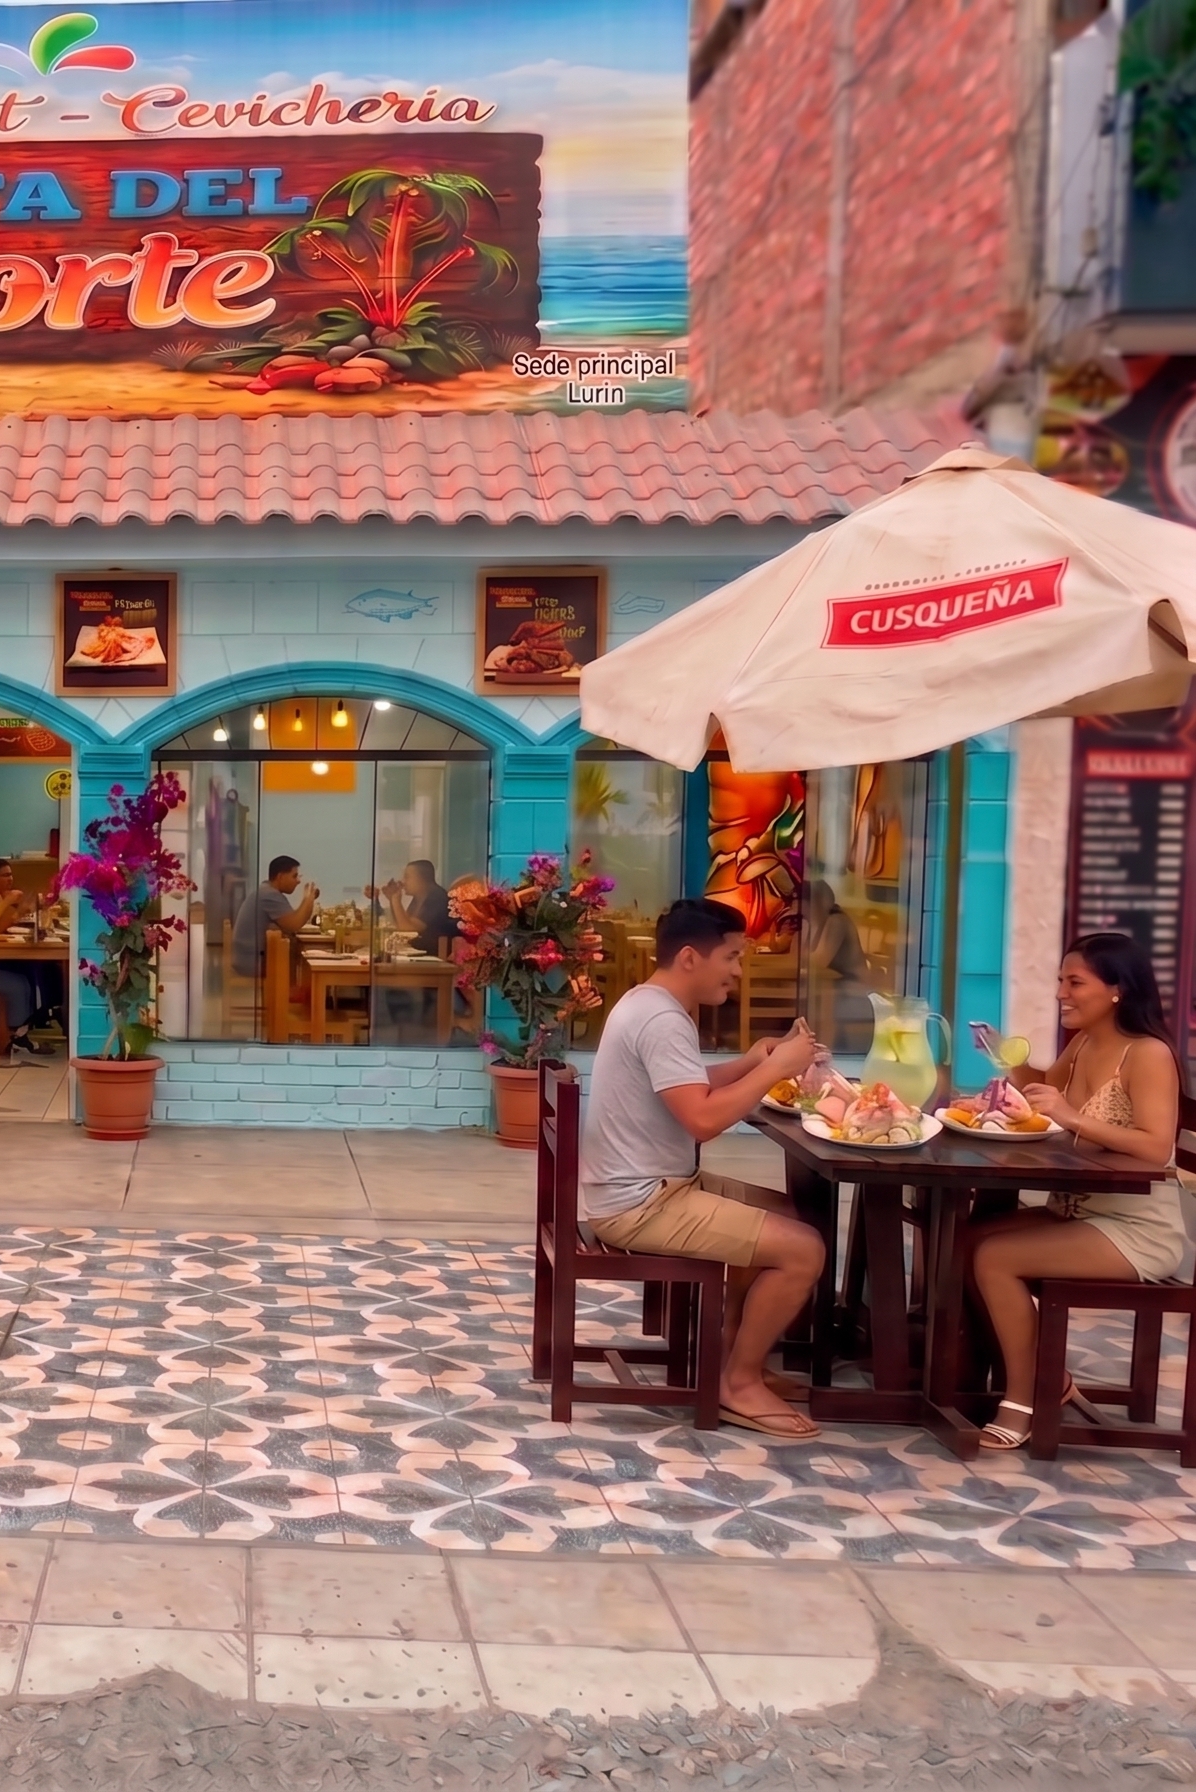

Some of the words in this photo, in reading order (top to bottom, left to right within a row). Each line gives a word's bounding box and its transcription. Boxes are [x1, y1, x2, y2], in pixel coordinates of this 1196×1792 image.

[109, 168, 310, 218] DEL
[514, 353, 570, 376] Sede
[578, 352, 673, 381] principal
[568, 382, 624, 403] Lurin
[850, 578, 1035, 634] CUSQUEÑA
